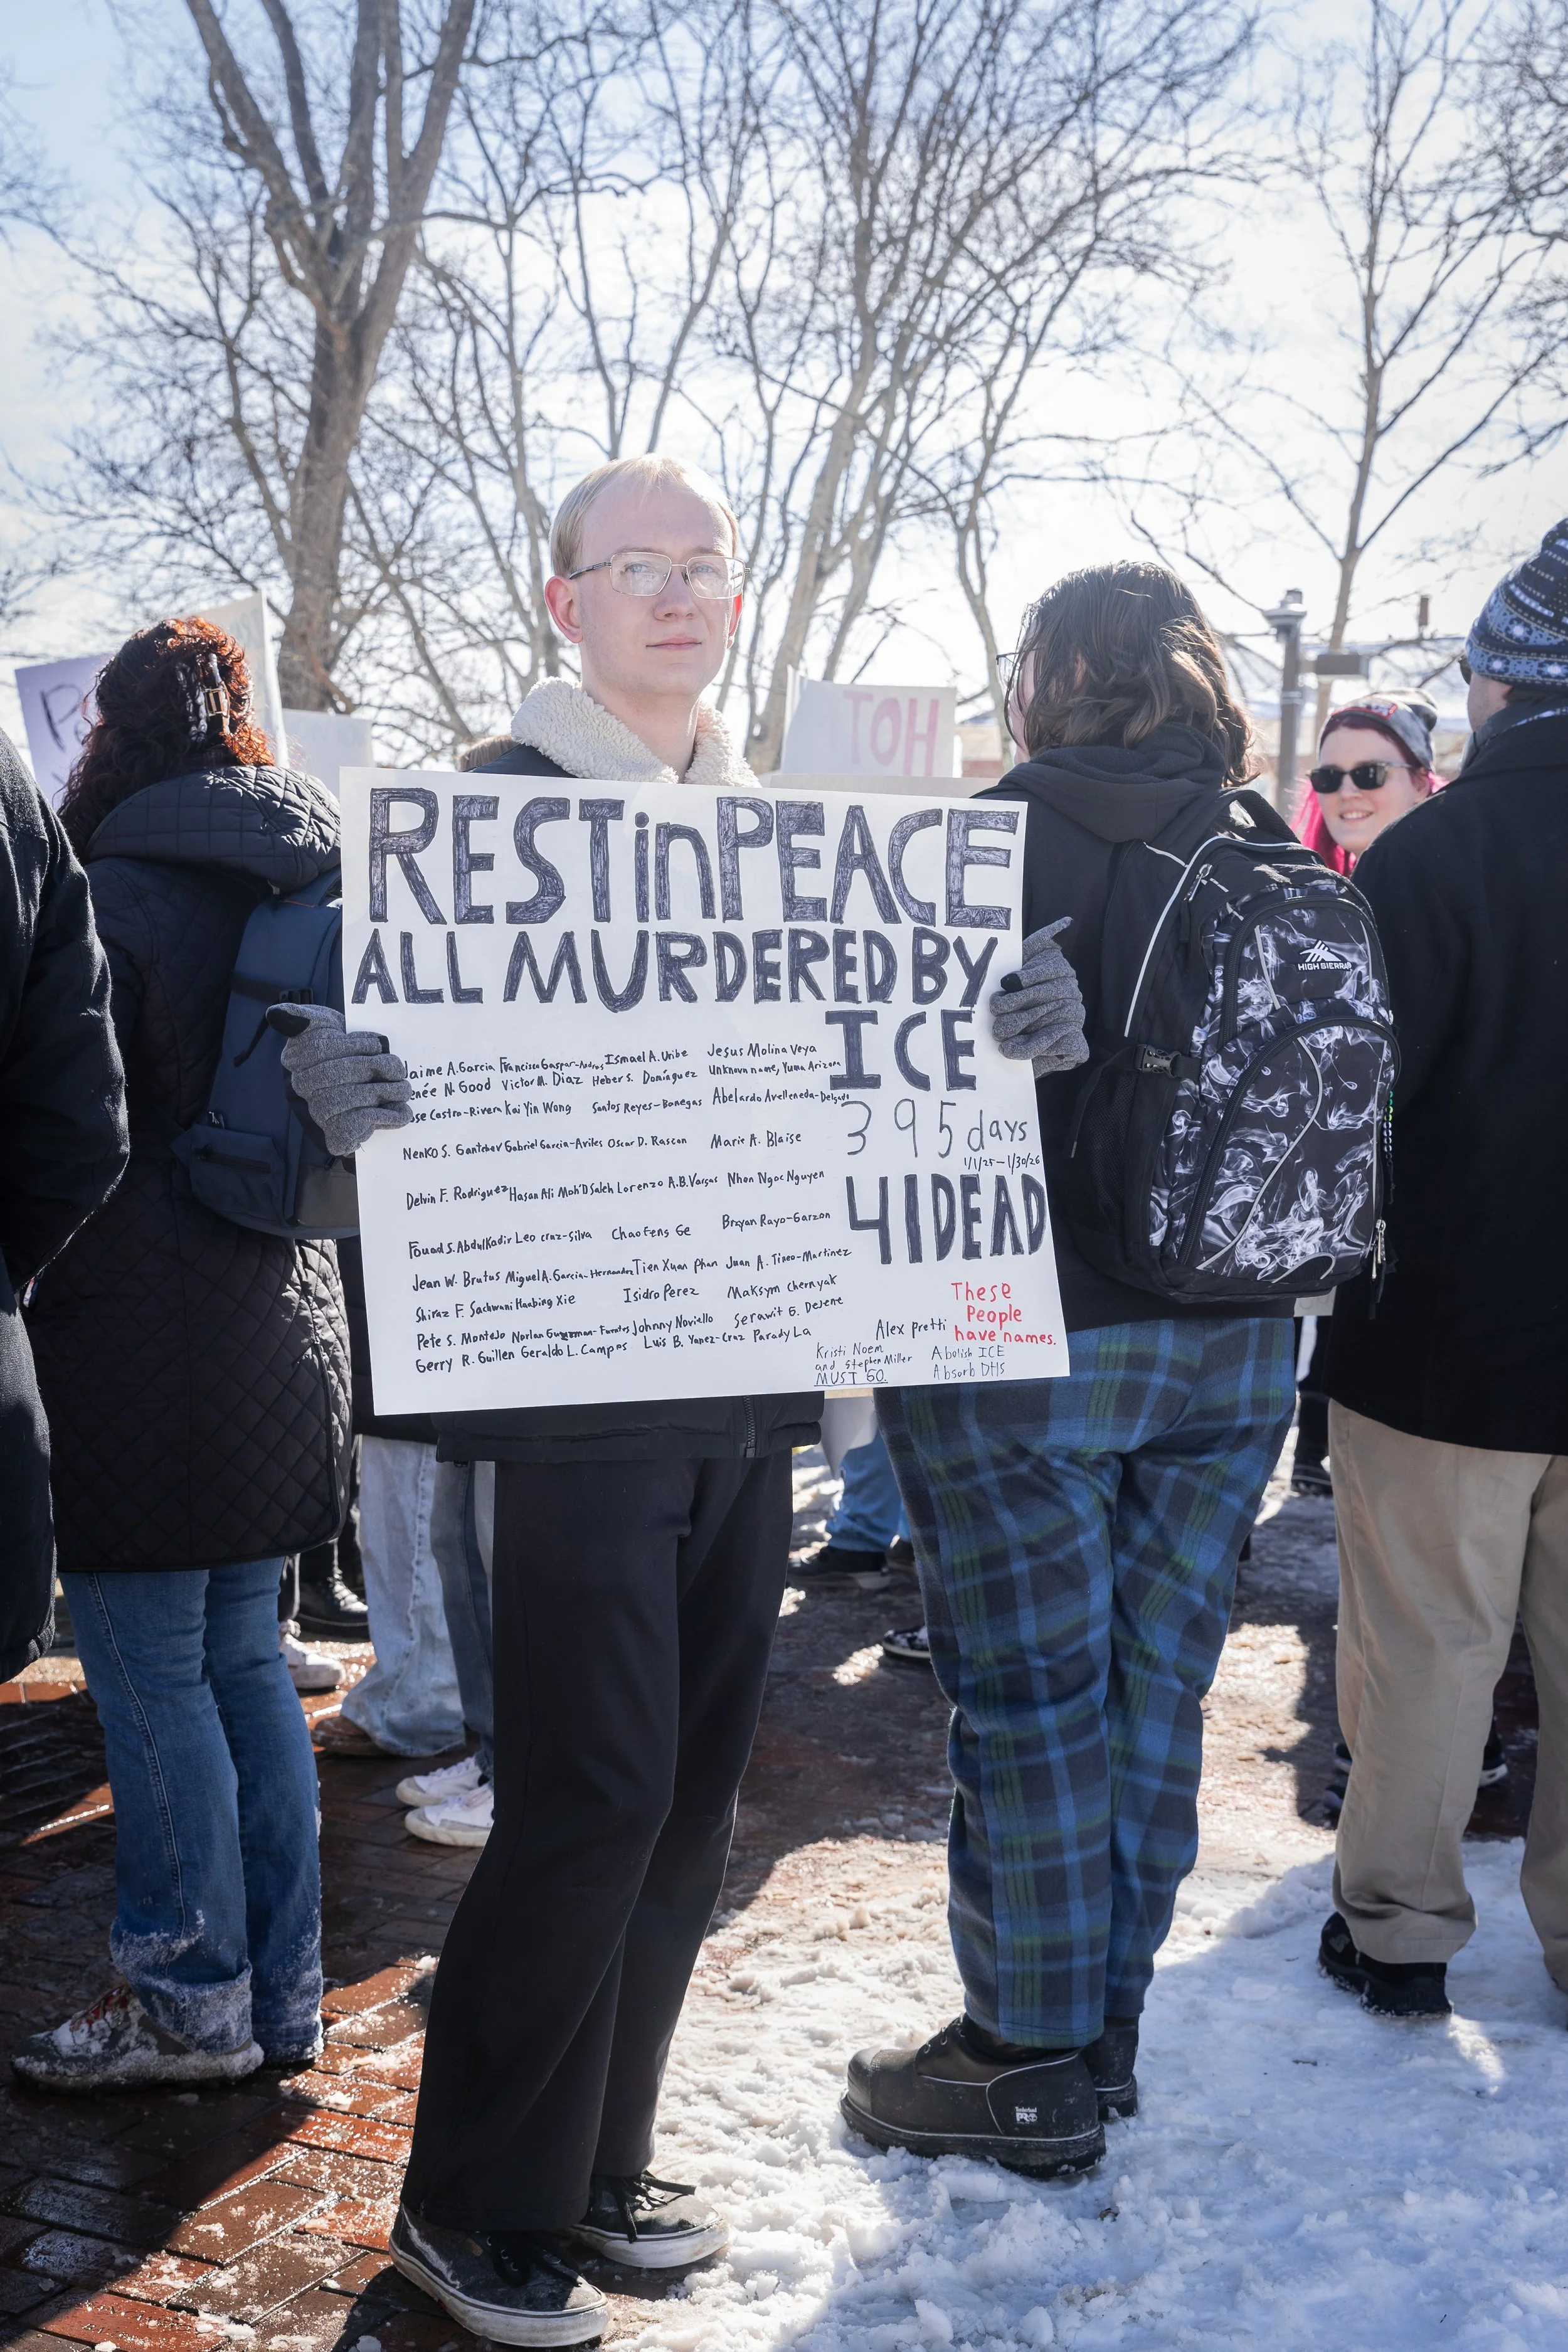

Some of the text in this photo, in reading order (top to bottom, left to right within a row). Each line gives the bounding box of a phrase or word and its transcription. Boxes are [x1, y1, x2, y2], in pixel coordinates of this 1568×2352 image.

[351, 926, 998, 1014] ALL MURDERED BY
[1321, 962, 1348, 970] SIERRA
[604, 1051, 646, 1065] Ismael
[661, 1048, 689, 1062] Uribe
[707, 1043, 744, 1059] Jesus
[746, 1042, 788, 1058] Molina
[790, 1044, 817, 1057] Veya
[825, 1010, 977, 1091] ICE
[458, 1077, 491, 1094] Good
[501, 1077, 535, 1091] Victor
[552, 1071, 584, 1087] Diaz
[592, 1074, 624, 1087] Heber
[807, 1060, 842, 1073] Arizona
[504, 1099, 521, 1116] Kai
[522, 1101, 539, 1118] Yin
[542, 1100, 572, 1116] Wong
[592, 1099, 621, 1114] Santos
[712, 1086, 762, 1106] Abelardo
[504, 1138, 538, 1153] Gabriel
[607, 1138, 635, 1148] Oscar
[637, 1136, 648, 1148] D.
[710, 1133, 745, 1150] Marie
[766, 1130, 802, 1148] Blaise
[967, 1109, 1028, 1153] days
[406, 1192, 437, 1211] Delvin
[509, 1186, 539, 1202] Hasan
[617, 1180, 664, 1194] Lorenzo
[787, 1169, 825, 1186] Nguyen
[408, 1241, 445, 1260] Fouad
[515, 1231, 536, 1244] Leo
[675, 1224, 692, 1237] Ge
[412, 1273, 441, 1292] Jean
[462, 1270, 501, 1288] Brutus
[505, 1269, 540, 1288] Miguel
[632, 1258, 660, 1275] Tien
[662, 1258, 688, 1272] Xuan
[726, 1256, 751, 1269] Juan
[415, 1306, 450, 1323] Shiraz
[556, 1294, 576, 1306] Xie
[622, 1287, 660, 1303] Isidro
[663, 1283, 700, 1301] Perez
[951, 1281, 1012, 1303] These
[876, 1318, 904, 1341] Alex
[967, 1303, 1022, 1331] People
[416, 1333, 442, 1351] Pete
[632, 1318, 672, 1337] Johnny
[675, 1313, 714, 1329] Noviello
[954, 1325, 1056, 1345] have names.
[415, 1357, 453, 1374] Gerry
[462, 1353, 475, 1367] R.
[477, 1348, 515, 1364] Guillen
[521, 1343, 564, 1359] Geraldo
[643, 1335, 667, 1349] Luis
[753, 1328, 790, 1343] Parady
[793, 1326, 812, 1338] La
[815, 1360, 835, 1372] and
[884, 1352, 913, 1365] Miller
[816, 1342, 884, 1359] Kristi Noem
[931, 1345, 1005, 1360] Abolish ICE
[815, 1371, 858, 1385] MUST
[933, 1361, 1005, 1380] Absorb DHS
